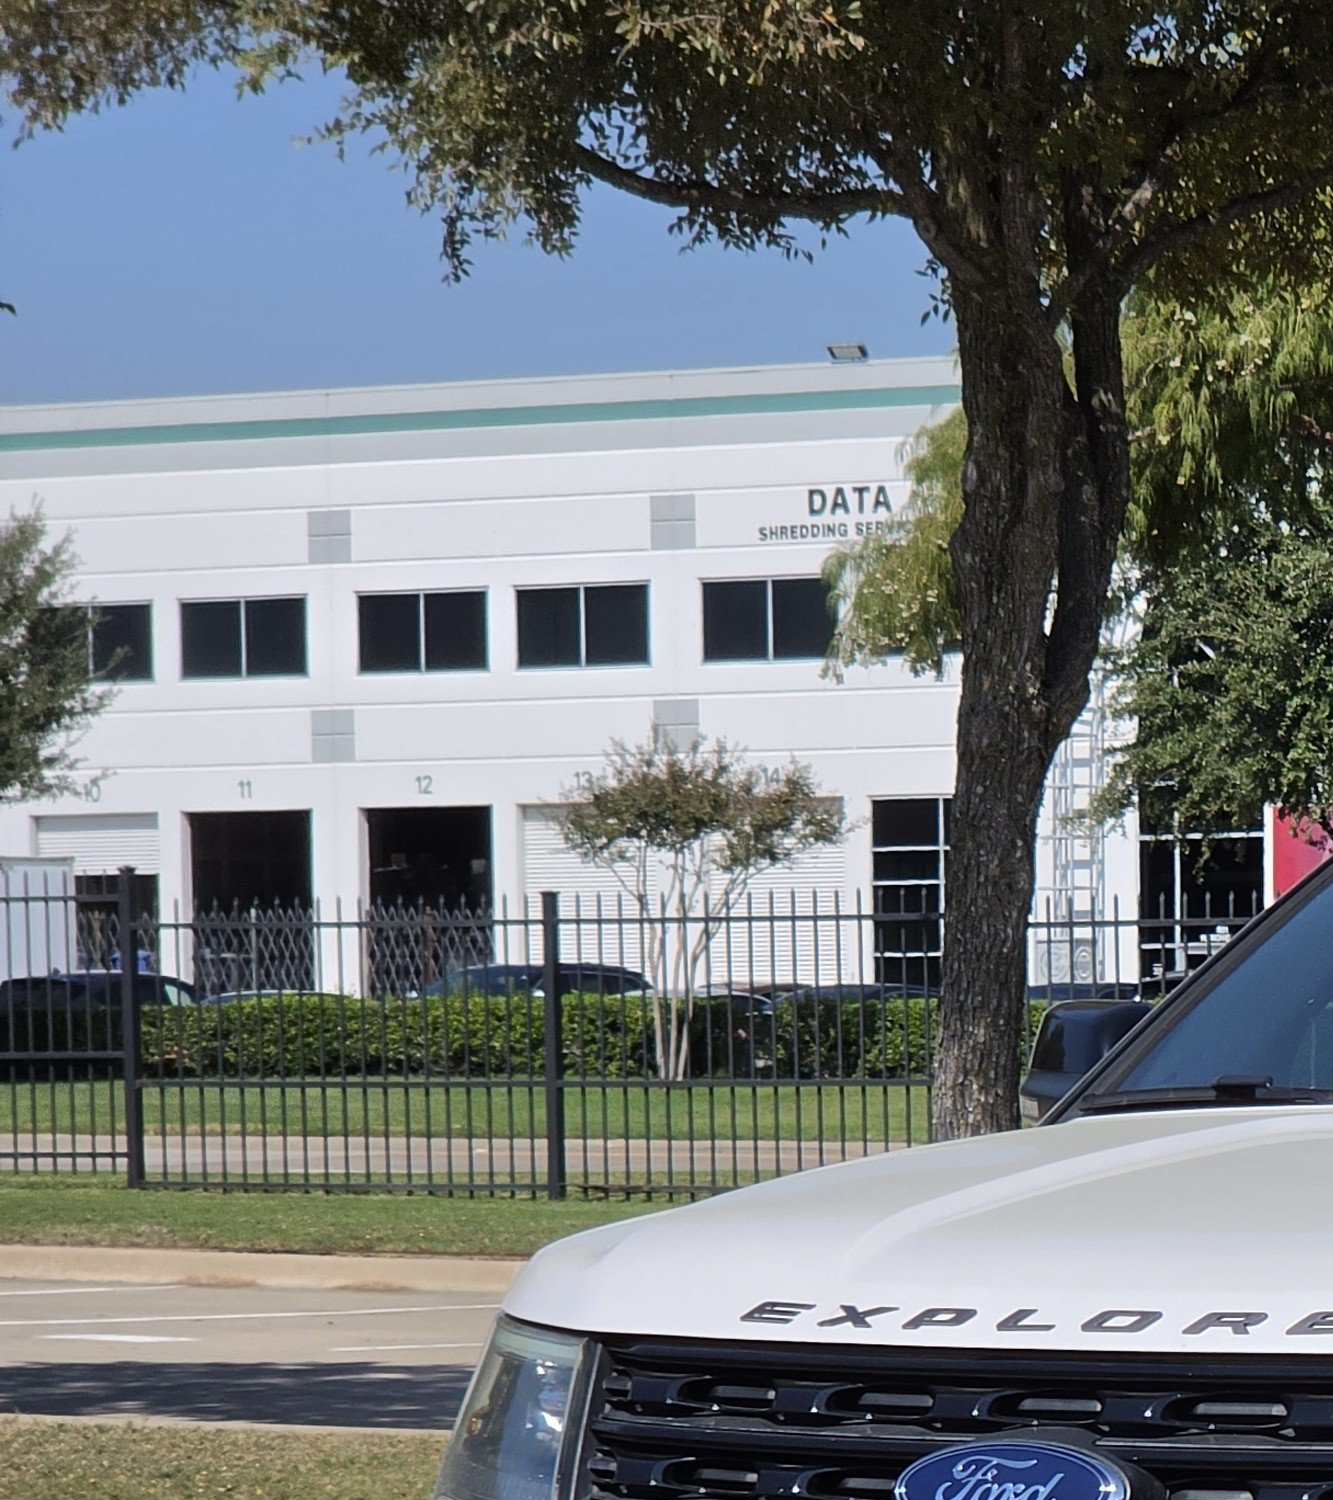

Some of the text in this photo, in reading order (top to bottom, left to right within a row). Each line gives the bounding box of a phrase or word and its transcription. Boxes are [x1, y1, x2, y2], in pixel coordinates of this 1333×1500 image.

[807, 485, 893, 517] DATA
[758, 523, 848, 541] SHREDDING
[416, 775, 434, 795] 12
[574, 770, 594, 792] 13
[761, 767, 780, 786] 14
[238, 780, 253, 799] 11
